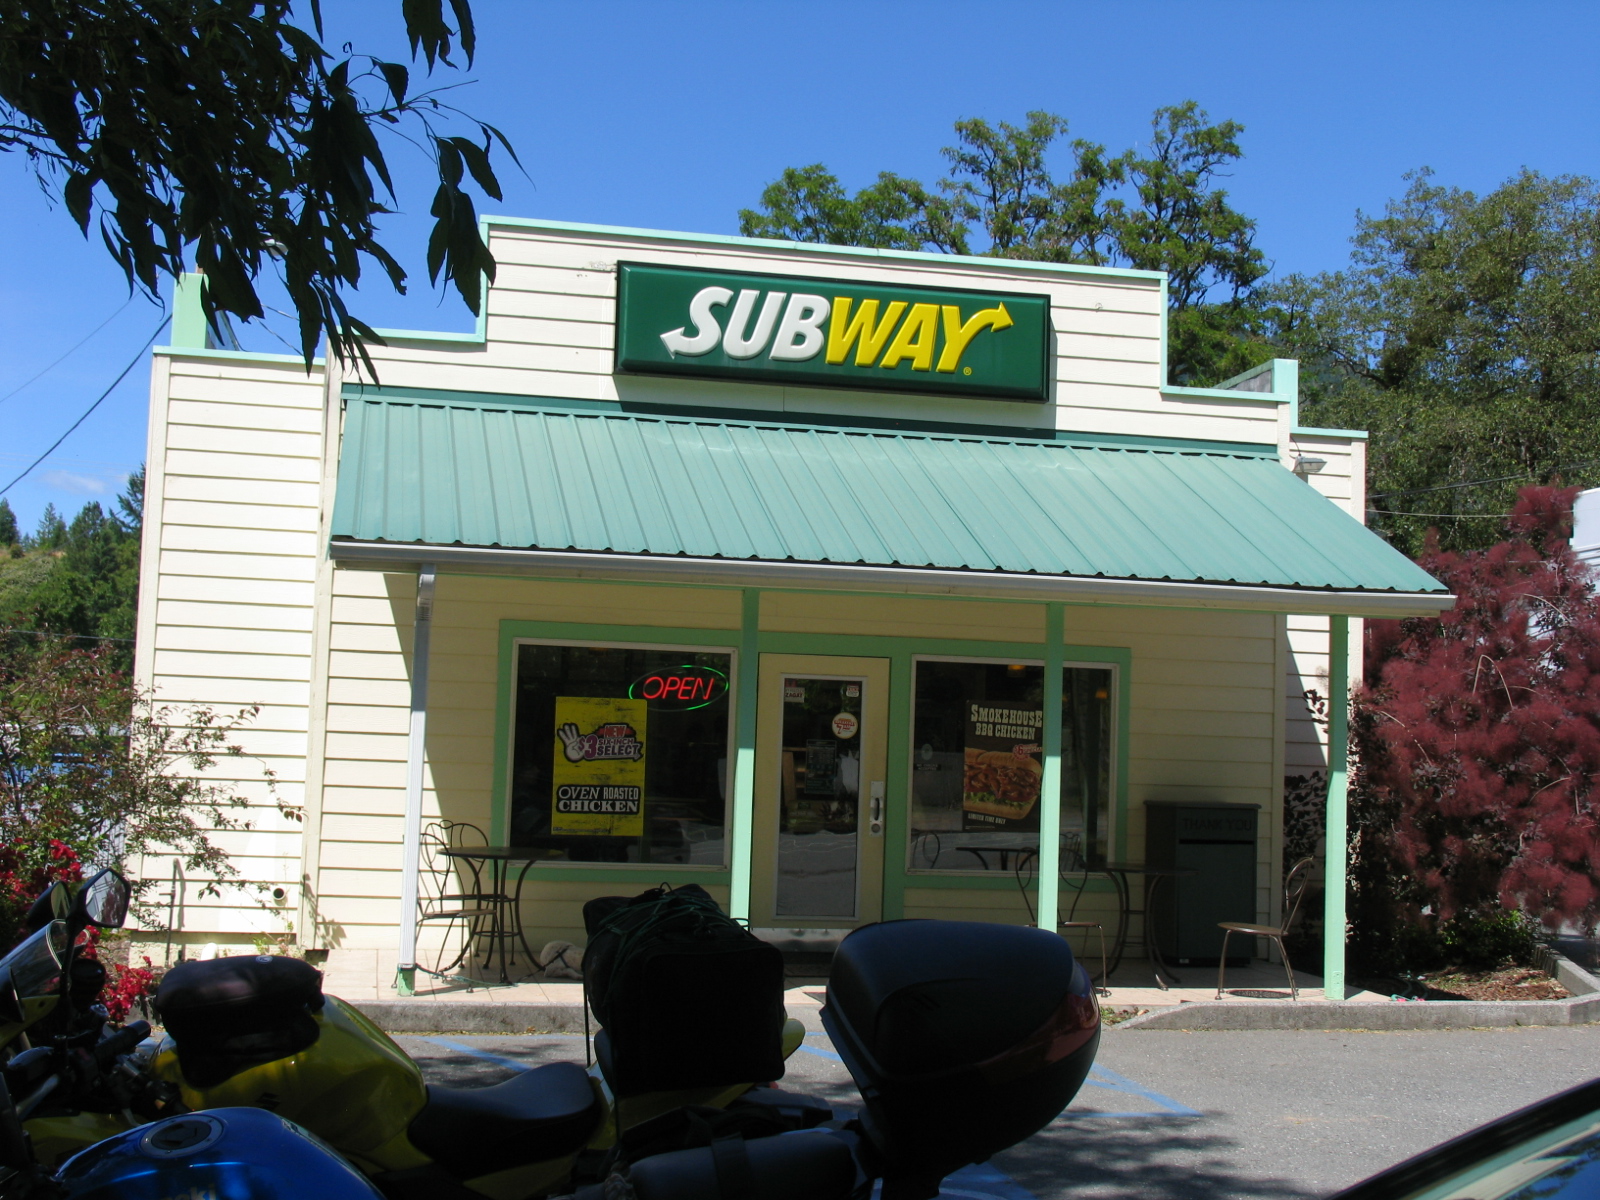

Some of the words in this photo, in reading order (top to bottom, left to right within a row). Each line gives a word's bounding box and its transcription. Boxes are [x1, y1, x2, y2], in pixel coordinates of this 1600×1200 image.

[659, 286, 1013, 374] SUBWAY
[642, 676, 715, 700] OPEN
[970, 703, 1043, 728] SMOKEHOUSE
[604, 725, 627, 738] NEW
[975, 722, 994, 737] BBQ
[995, 724, 1036, 741] CHICKEN
[578, 734, 598, 759] $3
[598, 737, 635, 746] SIX-INCH
[597, 744, 640, 757] SELECT
[558, 786, 600, 799] OVEN
[603, 787, 639, 800] ROASTED
[558, 799, 639, 813] CHICKEN
[1183, 817, 1222, 831] THANK
[1226, 818, 1252, 832] YOU
